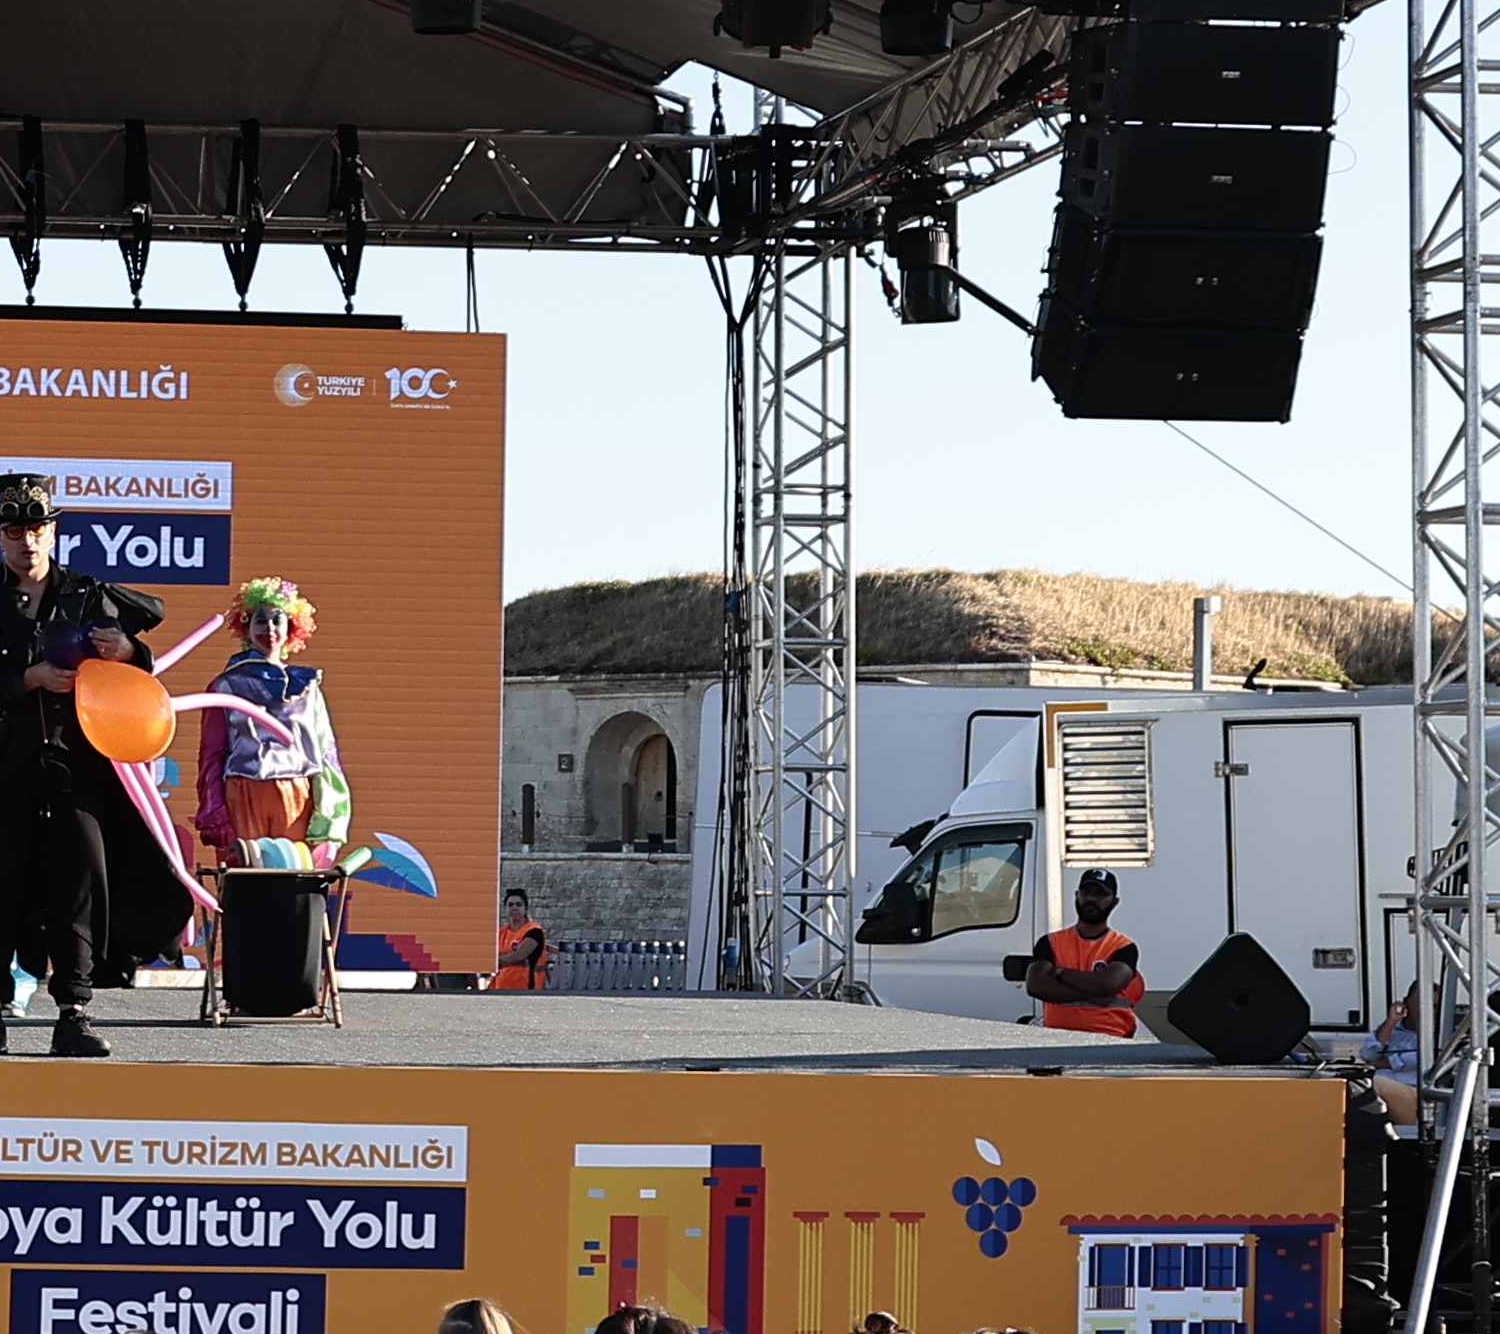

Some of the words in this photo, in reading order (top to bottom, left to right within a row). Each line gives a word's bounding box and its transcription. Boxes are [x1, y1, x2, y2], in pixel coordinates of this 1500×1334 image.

[64, 471, 220, 500] BAKANLIĞI
[90, 523, 205, 569] Yolu
[561, 757, 568, 769] 2
[92, 1139, 135, 1165] VE
[142, 1135, 268, 1168] TURİZM
[276, 1138, 454, 1171] BAKANLIĞI
[100, 1195, 296, 1248] Kültür
[306, 1198, 437, 1250] Yolu
